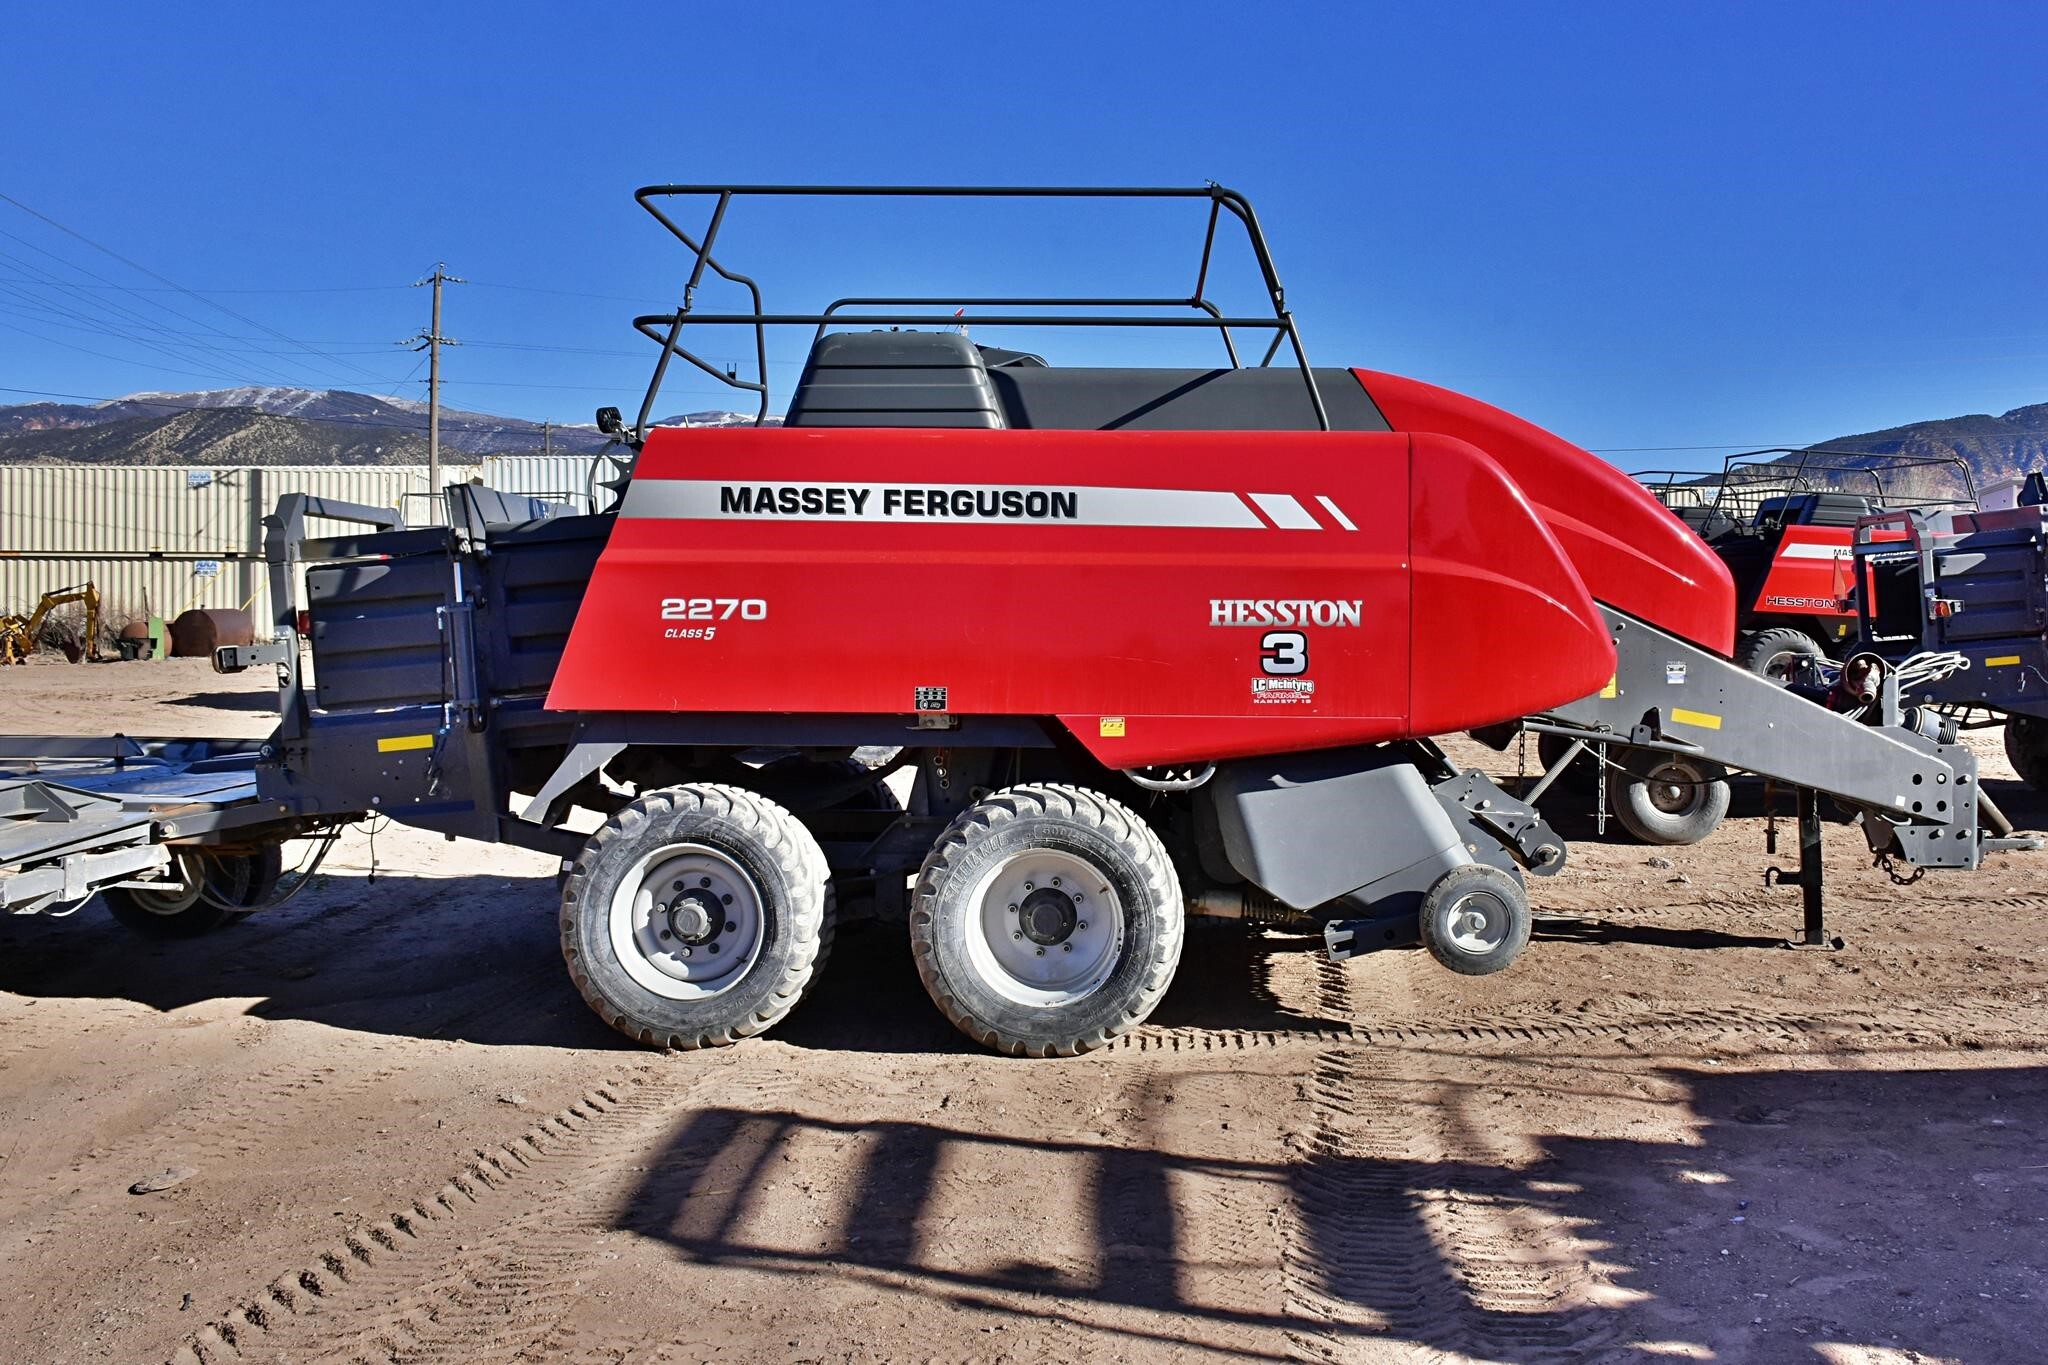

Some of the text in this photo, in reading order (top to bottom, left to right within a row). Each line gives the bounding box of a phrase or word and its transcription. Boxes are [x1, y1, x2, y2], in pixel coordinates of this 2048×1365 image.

[720, 486, 1078, 519] MASSEY FERGUSON
[1833, 548, 1854, 557] MAS
[660, 598, 768, 621] 2270
[1765, 595, 1836, 609] HESSTON
[1209, 599, 1363, 627] HESSTON
[664, 626, 717, 641] CLASS 5
[1260, 630, 1308, 676] 3
[1252, 677, 1314, 694] LC McIntyre
